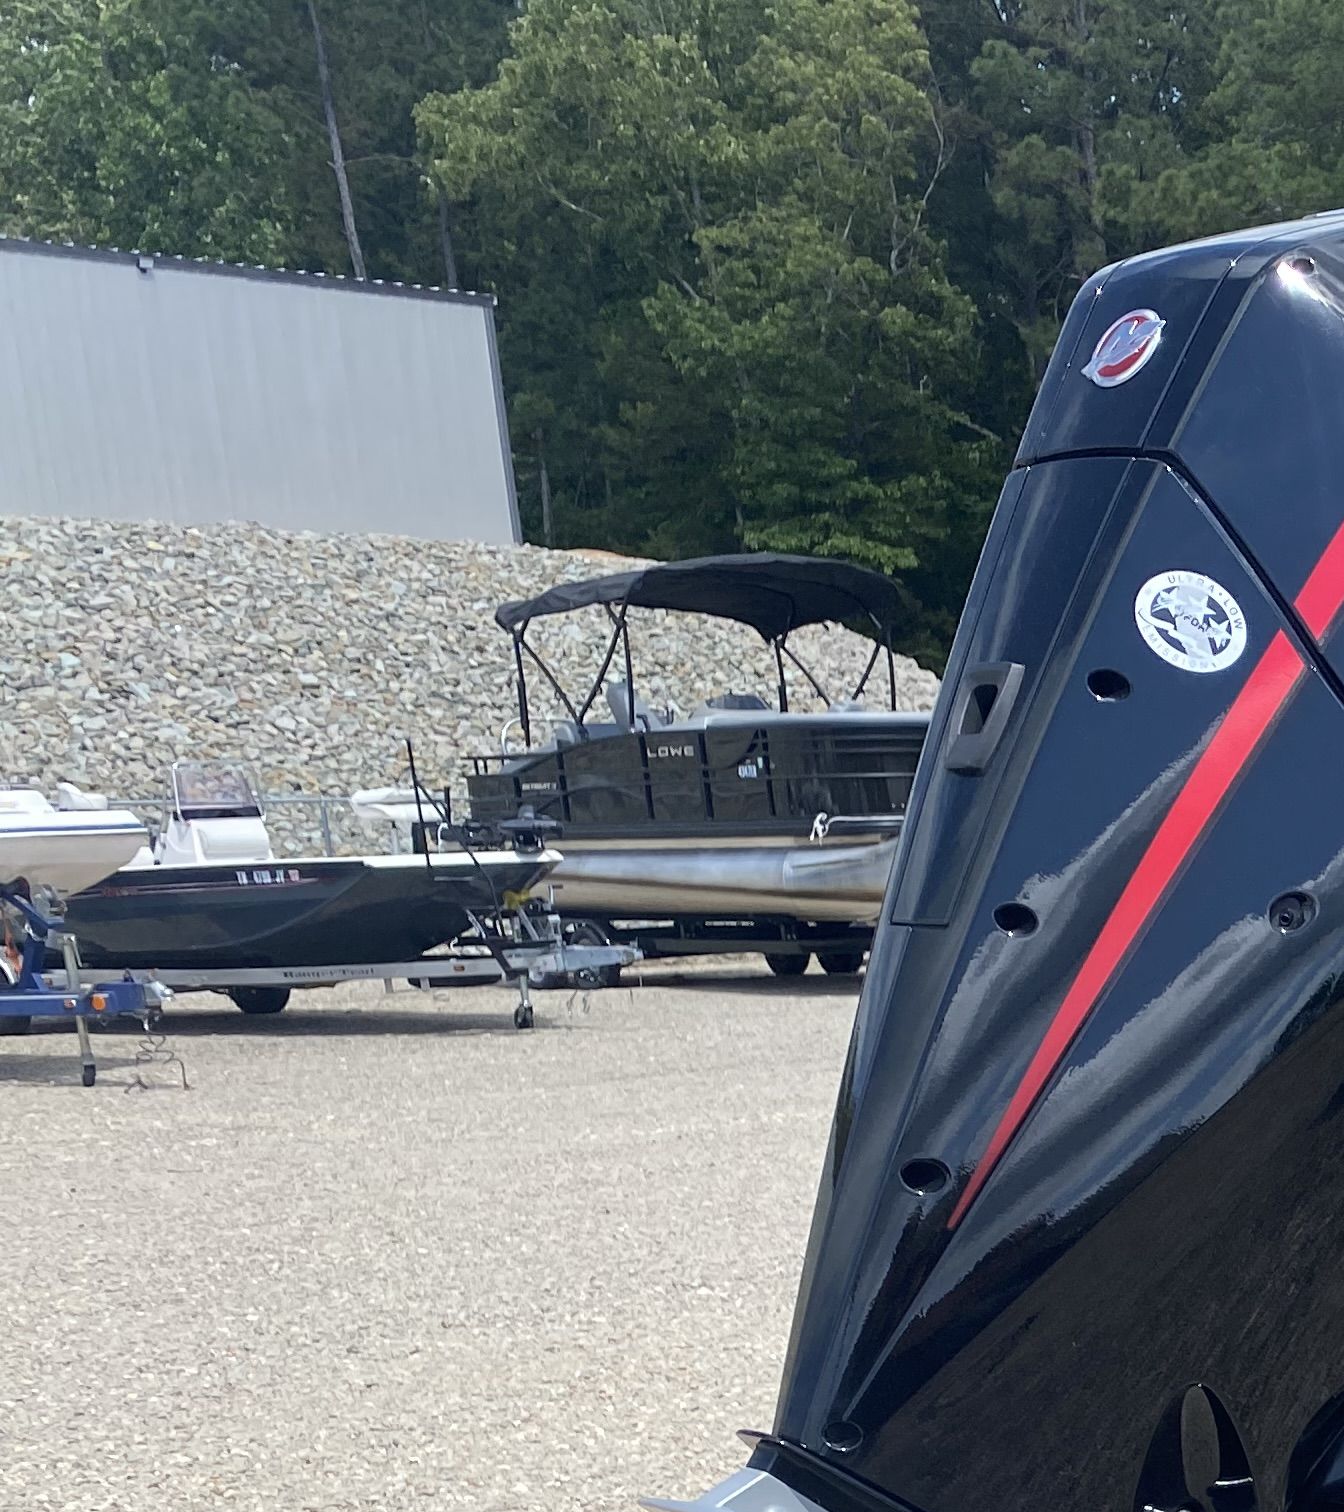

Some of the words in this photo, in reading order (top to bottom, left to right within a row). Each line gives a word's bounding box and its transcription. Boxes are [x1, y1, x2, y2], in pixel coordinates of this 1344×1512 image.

[1167, 575, 1215, 594] ULTRA
[1223, 598, 1243, 630] LOW
[646, 745, 694, 757] LOWE
